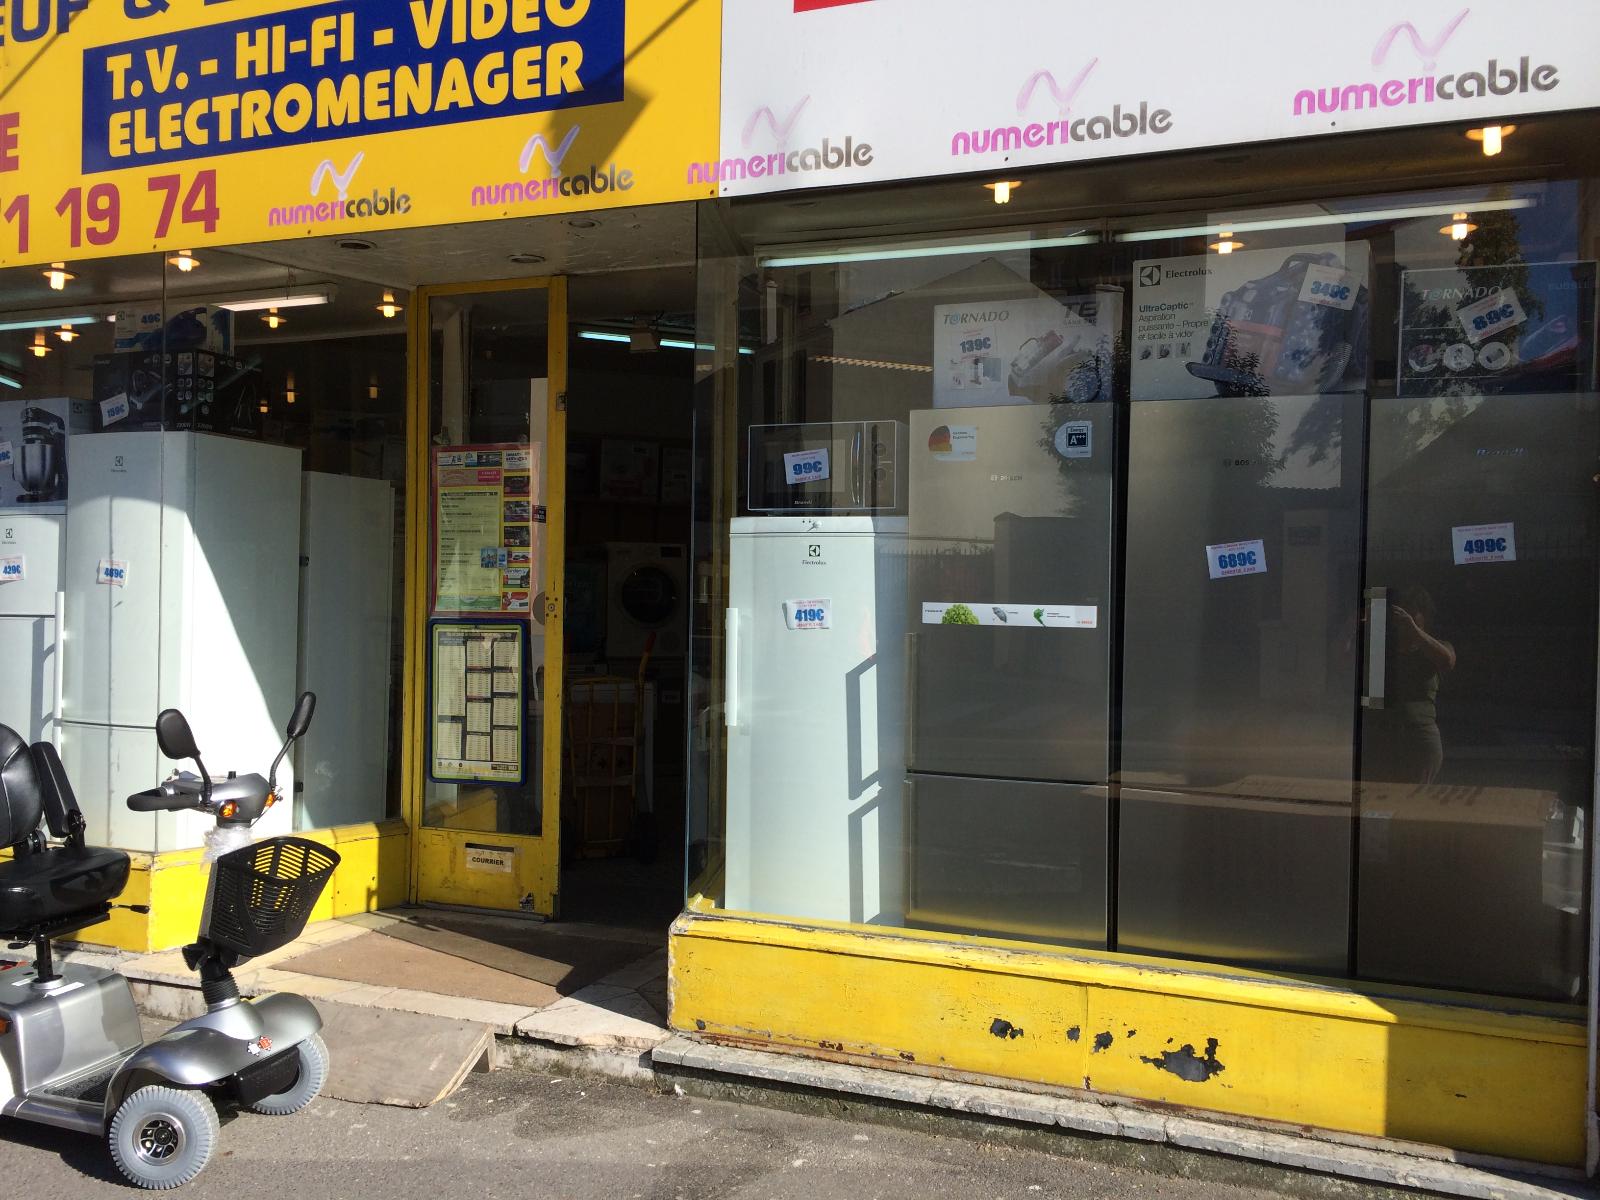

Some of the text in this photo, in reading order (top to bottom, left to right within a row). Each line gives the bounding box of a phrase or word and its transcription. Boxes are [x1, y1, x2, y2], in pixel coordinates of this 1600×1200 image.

[106, 45, 188, 100] T.V.
[235, 12, 355, 80] HI-FI
[409, 0, 590, 50] VIDEO
[108, 41, 585, 158] ELECTROMENAGER
[1294, 57, 1560, 116] numericable
[951, 101, 1173, 156] numericable
[687, 136, 875, 185] numericable
[472, 163, 634, 207] numericable
[55, 183, 120, 248] 19
[147, 169, 220, 239] 74
[268, 187, 411, 227] numericable
[1165, 269, 1213, 280] Electrolux
[943, 311, 1010, 326] TORNADO
[959, 337, 991, 354] 139€
[792, 460, 823, 476] 99€
[1218, 550, 1257, 569] 689€
[1463, 537, 1507, 555] 499€
[794, 608, 825, 622] 419€
[471, 856, 505, 866] COURRIER
